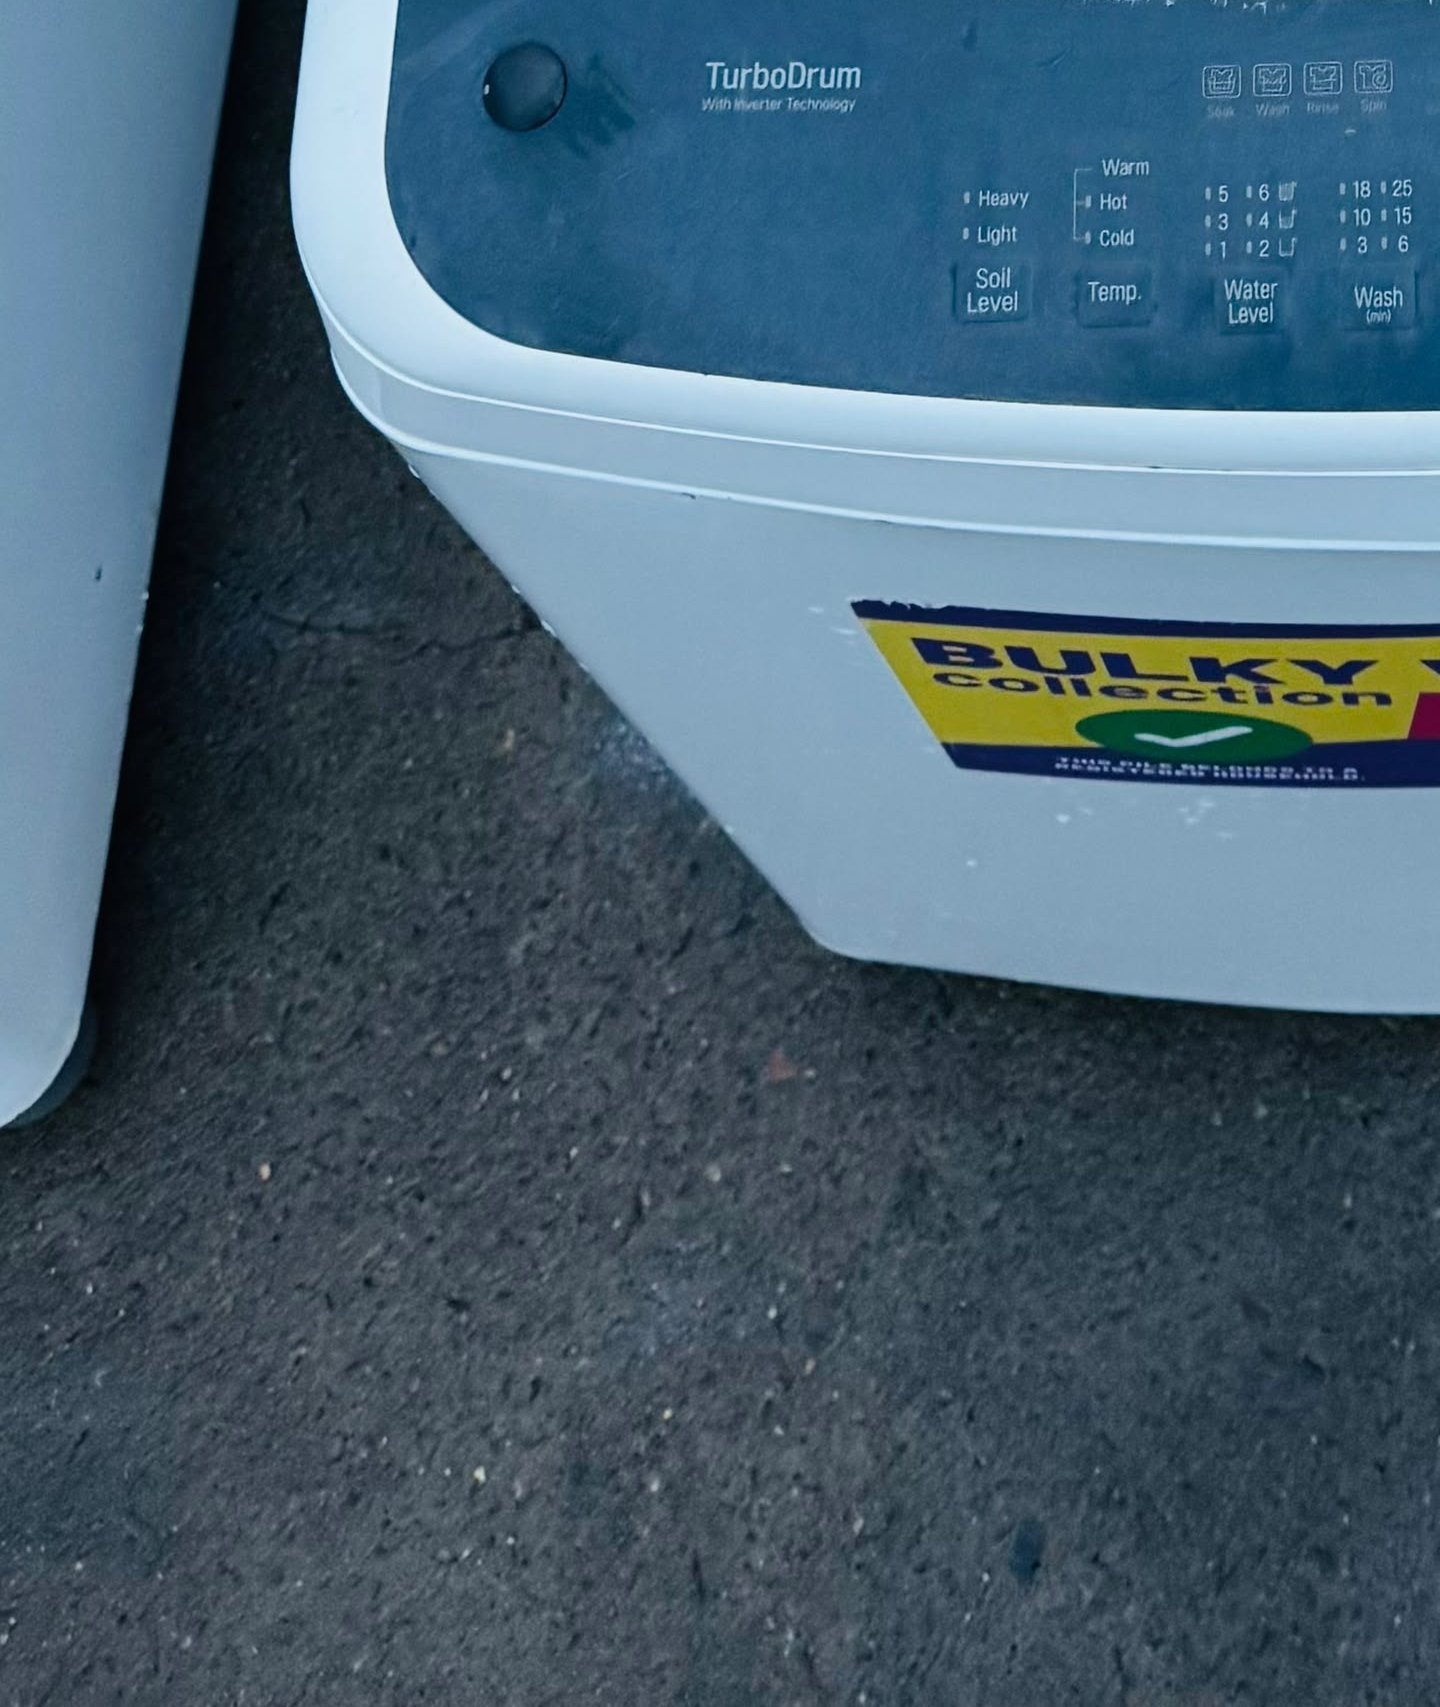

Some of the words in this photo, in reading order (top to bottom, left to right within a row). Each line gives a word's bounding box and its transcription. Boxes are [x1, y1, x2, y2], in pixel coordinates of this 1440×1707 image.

[706, 61, 861, 89] TurboDrum
[734, 97, 781, 111] Inverter
[788, 97, 856, 114] Technology
[1102, 159, 1149, 176] Warm
[1218, 185, 1229, 202] 5
[1259, 184, 1270, 202] 6
[1352, 181, 1371, 197] 18
[1392, 179, 1413, 197] 25
[978, 190, 1029, 209] Heavy
[1100, 194, 1127, 211] Hot
[1218, 214, 1229, 230] 3
[1259, 212, 1269, 229] 4
[1353, 208, 1371, 226] 10
[1394, 207, 1412, 225] 15
[977, 226, 1017, 246] Light
[1100, 229, 1134, 247] Cold
[1398, 235, 1409, 253] 6
[1220, 242, 1227, 259] 1
[1258, 240, 1269, 257] 2
[1357, 237, 1368, 254] 3
[976, 267, 1011, 289] Soil
[1088, 281, 1142, 306] Temp.
[1224, 279, 1278, 300] Water
[1354, 285, 1403, 308] Wash
[967, 291, 1018, 313] Level
[1228, 302, 1273, 324] Level
[1366, 310, 1392, 324] (min)
[911, 637, 1379, 686] BULKY
